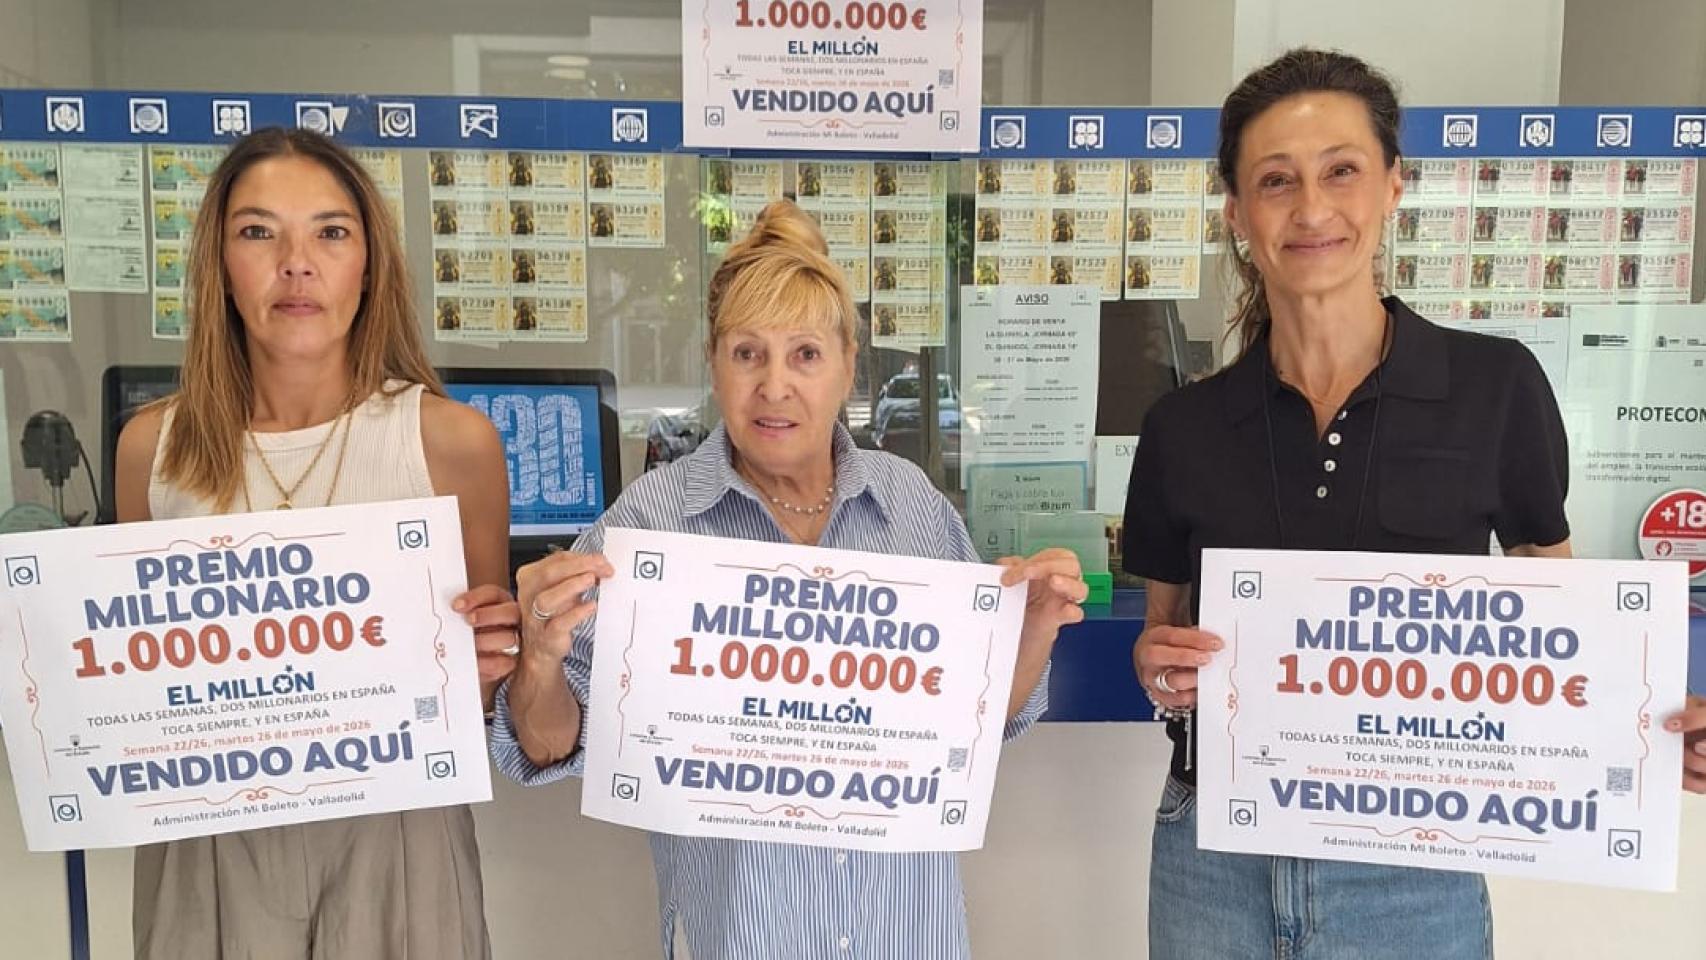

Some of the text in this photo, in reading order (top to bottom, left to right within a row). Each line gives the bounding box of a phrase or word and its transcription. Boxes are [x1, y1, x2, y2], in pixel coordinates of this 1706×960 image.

[787, 40, 808, 54] EL
[732, 82, 933, 117] VENDIDO AQUÍ
[1015, 293, 1049, 304] AVISO
[1660, 500, 1706, 529] +18
[136, 543, 313, 590] PREMIO
[84, 573, 370, 630] MILLONARIO
[745, 574, 898, 616] PREMIO
[1349, 586, 1523, 622] PREMIO
[692, 603, 939, 653] MILLONARIO
[1296, 619, 1578, 660] MILLONARIO
[87, 684, 396, 727] TODAS LAS SEMANAS, DOS MILLONARIOS EN ESPAÑA
[167, 685, 202, 706] EL
[743, 697, 772, 717] EL
[161, 709, 330, 736] TOCA SIEMPRE, Y EN ESPAÑA
[668, 712, 704, 722] TODAS
[707, 716, 725, 725] LAS
[727, 717, 781, 730] SEMANAS,
[786, 721, 807, 731] DOS
[883, 729, 896, 738] EN
[899, 730, 938, 740] ESPAÑA
[1357, 714, 1390, 734] EL
[124, 720, 371, 756] Semana 22/26, martes 26 de mayo de 2026
[730, 732, 876, 752] TOCA SIEMPRE, Y EN ESPAÑA
[1280, 731, 1588, 758] TODAS LAS SEMANAS, DOS MILLONARIOS EN ESPAÑA
[87, 720, 413, 796] VENDIDO AQUÍ
[1346, 752, 1514, 771] TOCA SIEMPRE, Y EN ESPAÑA
[655, 756, 941, 809] VENDIDO AQUÍ
[1307, 765, 1556, 791] Semana 22/26, martes 26 de mayo de 2026
[244, 806, 259, 814] Mi
[262, 802, 299, 812] Boleto
[1270, 778, 1598, 834] VENDIDO AQUÍ
[1411, 844, 1425, 852] Mi
[1430, 845, 1466, 856] Boleto
